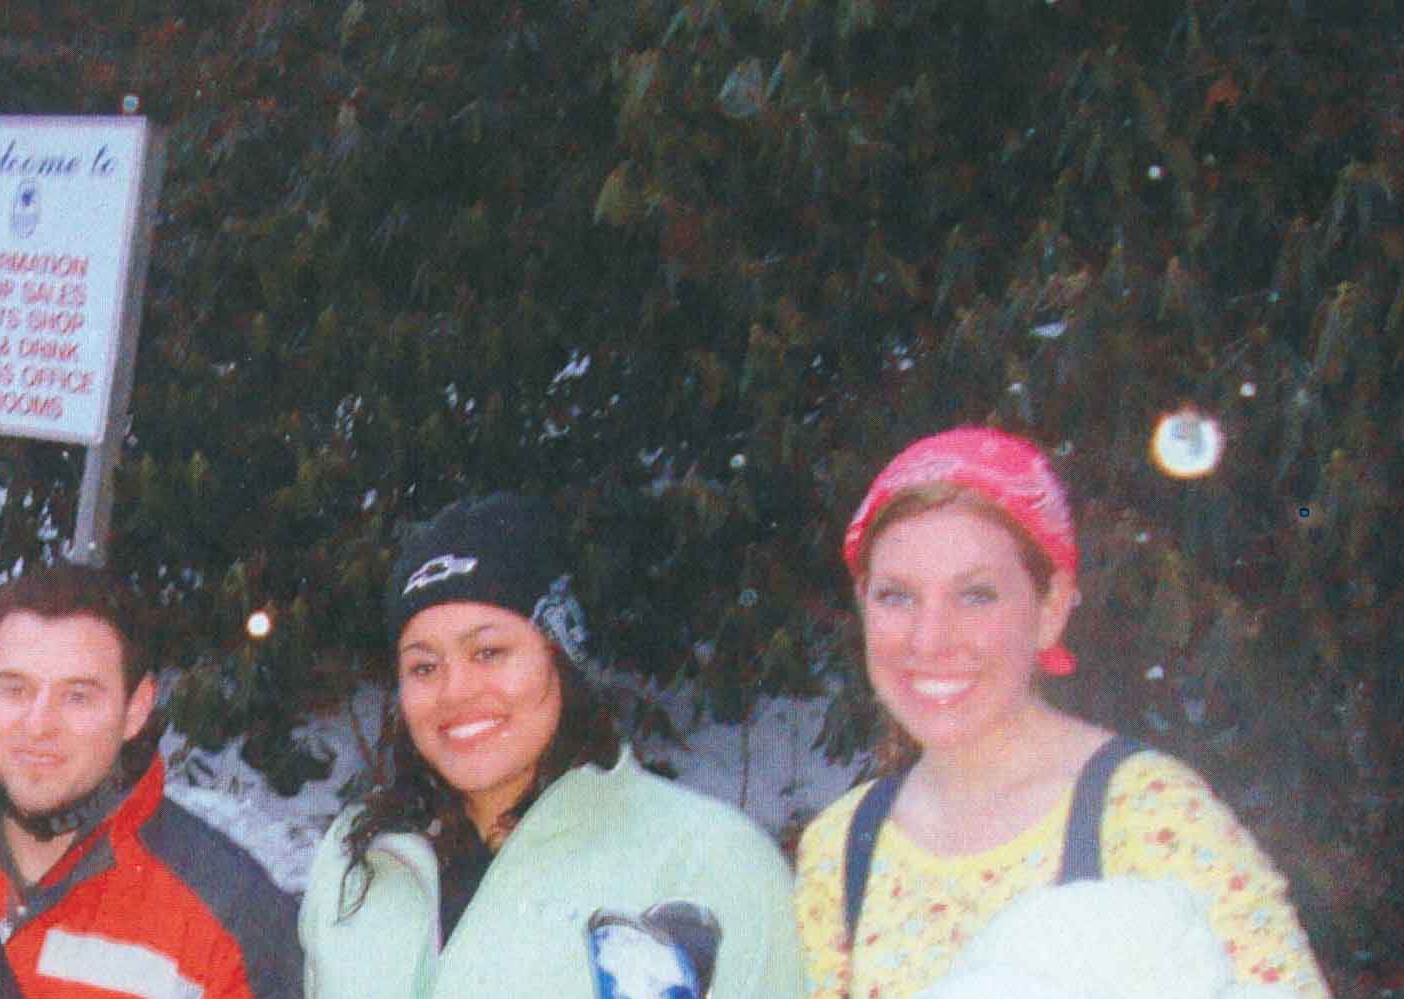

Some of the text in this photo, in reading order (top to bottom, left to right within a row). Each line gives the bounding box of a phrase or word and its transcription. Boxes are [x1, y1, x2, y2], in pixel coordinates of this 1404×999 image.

[91, 143, 117, 175] to
[21, 281, 87, 306] SALES
[26, 309, 84, 333] SHOP
[19, 337, 79, 362] DRINK
[21, 364, 97, 394] OFFICE
